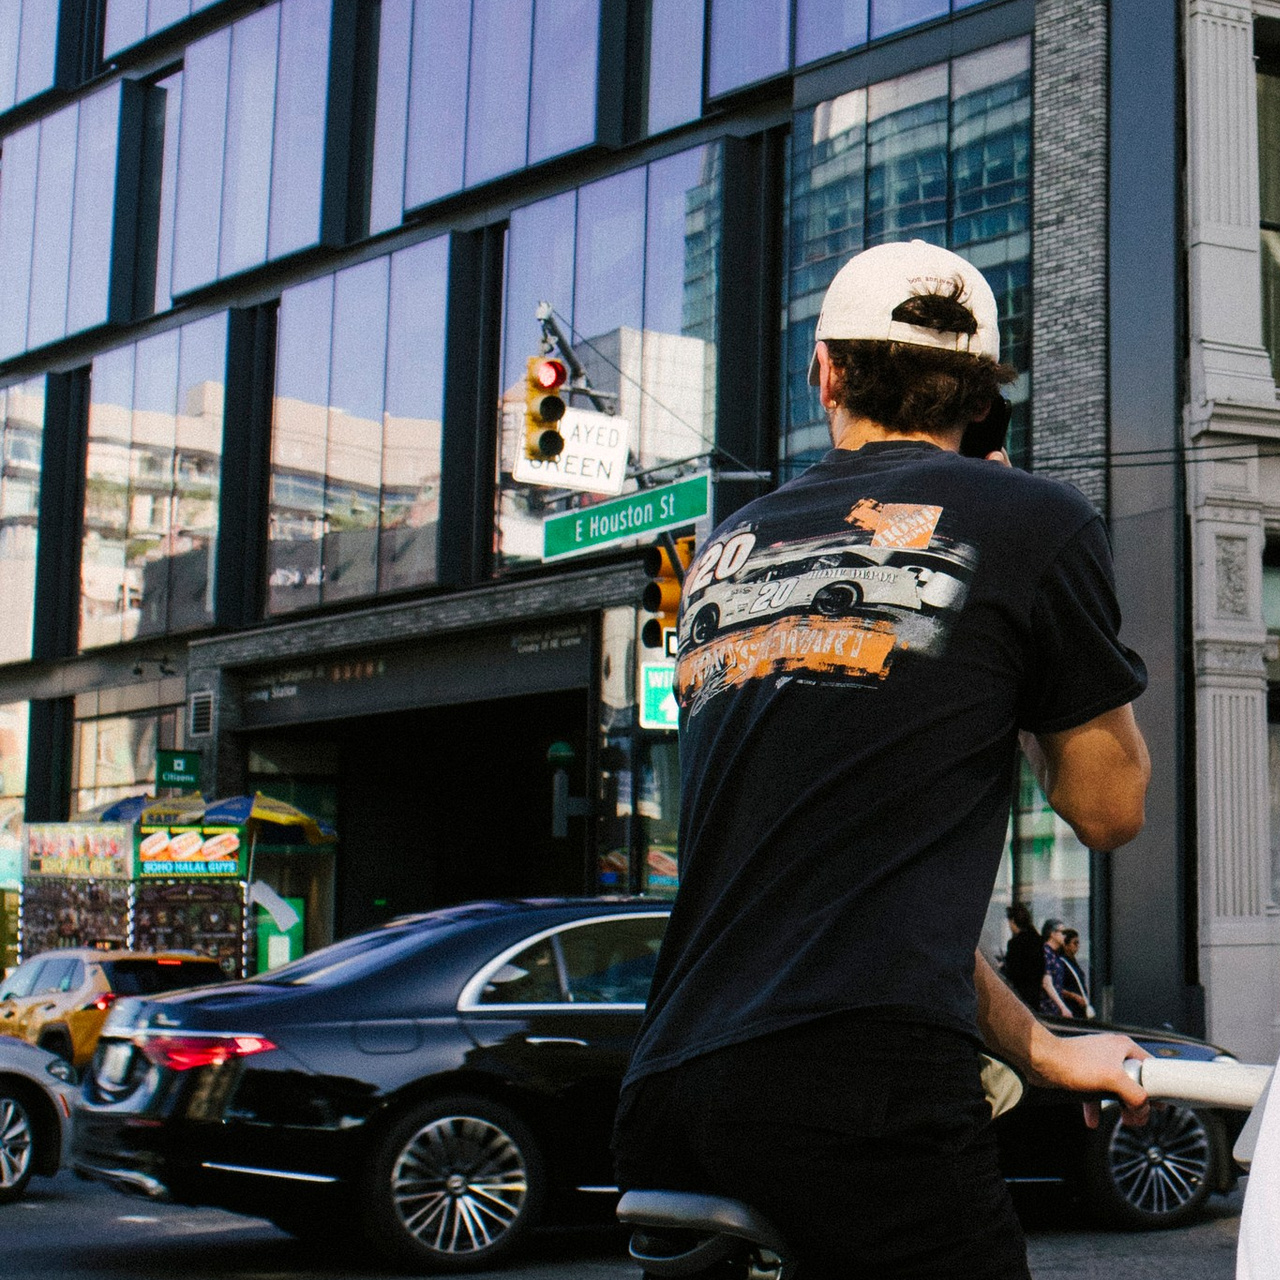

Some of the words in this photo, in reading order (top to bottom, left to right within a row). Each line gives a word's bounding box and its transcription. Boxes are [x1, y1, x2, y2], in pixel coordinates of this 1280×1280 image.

[570, 423, 620, 449] AYED
[575, 520, 583, 542] E
[590, 503, 653, 538] Houston
[660, 493, 675, 519] St
[689, 532, 756, 596] 20
[749, 576, 800, 614] 20
[162, 772, 195, 783] Citizens
[175, 861, 206, 873] HALAL
[208, 861, 235, 873] GUYS
